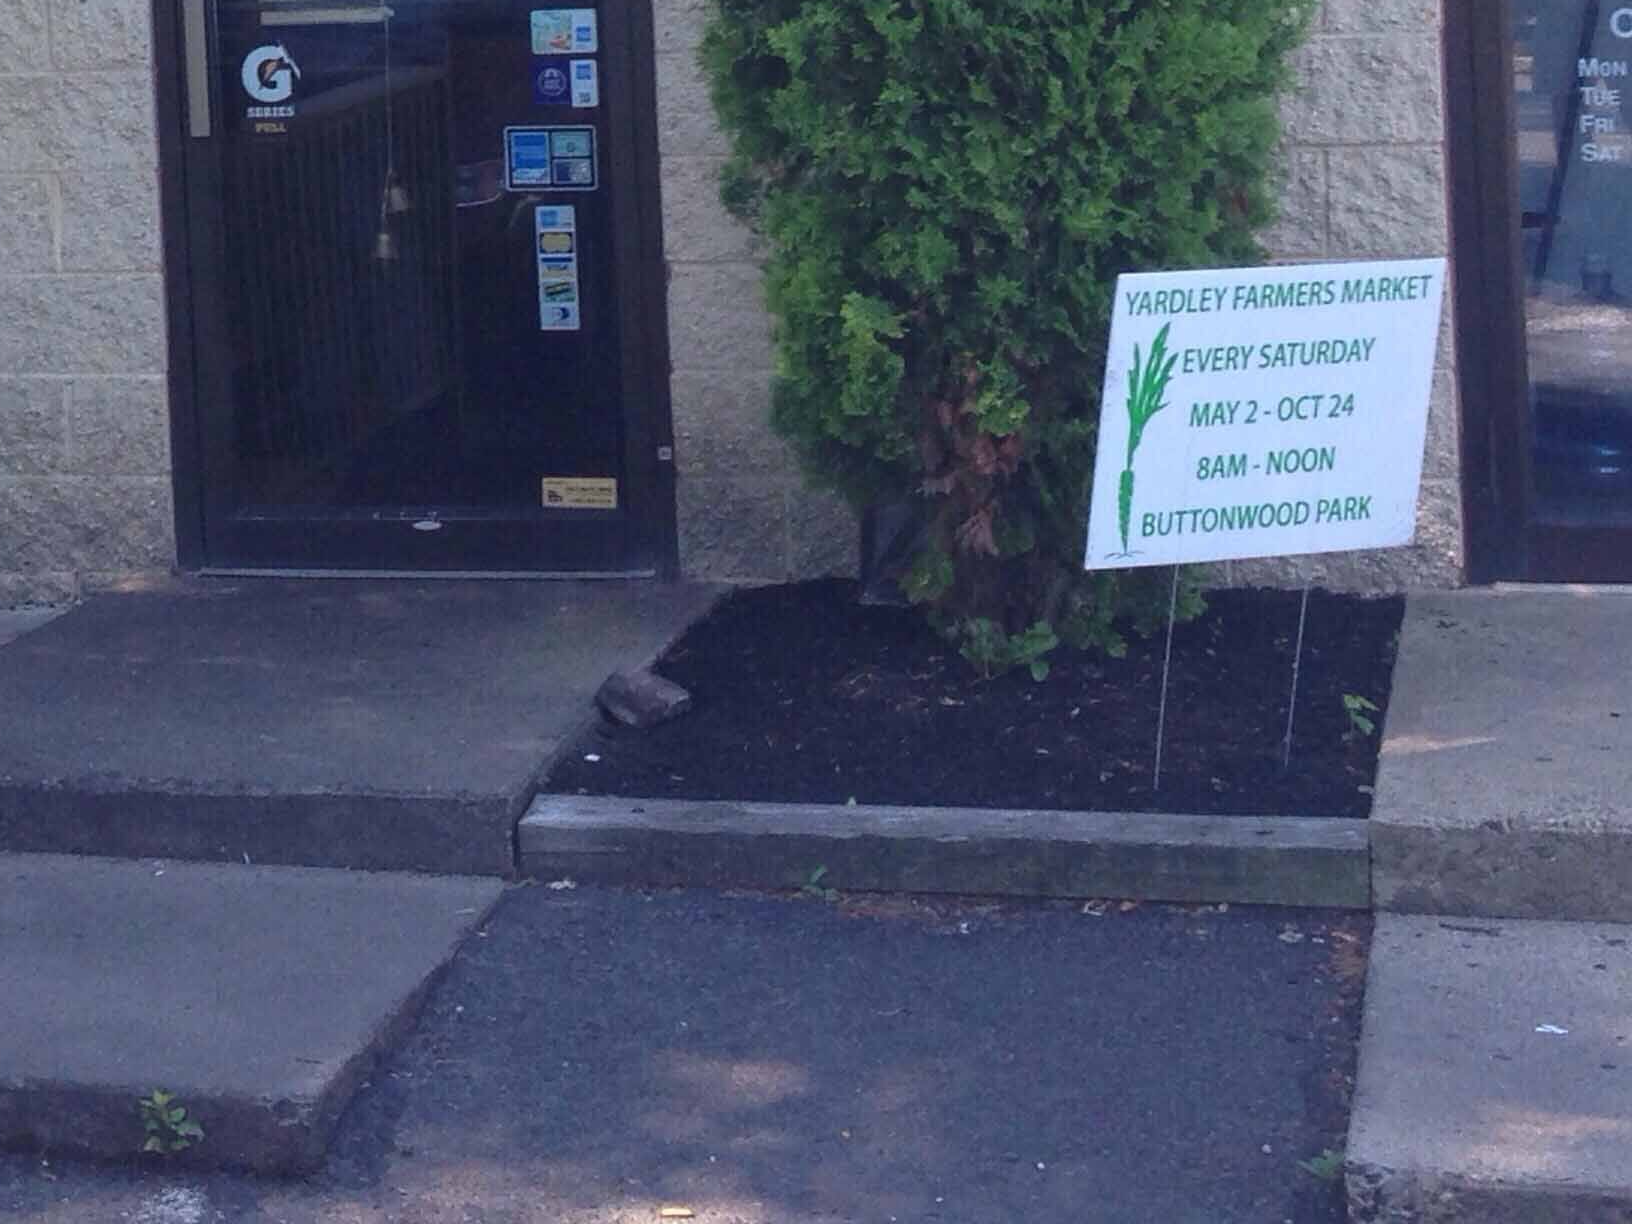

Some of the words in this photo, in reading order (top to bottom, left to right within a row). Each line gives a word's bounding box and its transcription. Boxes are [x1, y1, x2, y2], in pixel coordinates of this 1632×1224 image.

[1126, 285, 1228, 317] YARDLEY
[1233, 280, 1335, 311] FARMERS
[1341, 274, 1433, 304] MARKET
[1182, 345, 1254, 374] EVERY
[1258, 337, 1376, 369] SATURDAY
[1189, 402, 1238, 428] MAY
[1244, 399, 1258, 425] 2
[1277, 394, 1323, 421] OCT
[1328, 392, 1355, 418] 24
[1196, 453, 1247, 481] 8AM
[1267, 447, 1336, 475] NOON
[1141, 501, 1309, 537] BUTTONWOOD
[1316, 496, 1372, 523] PARK
